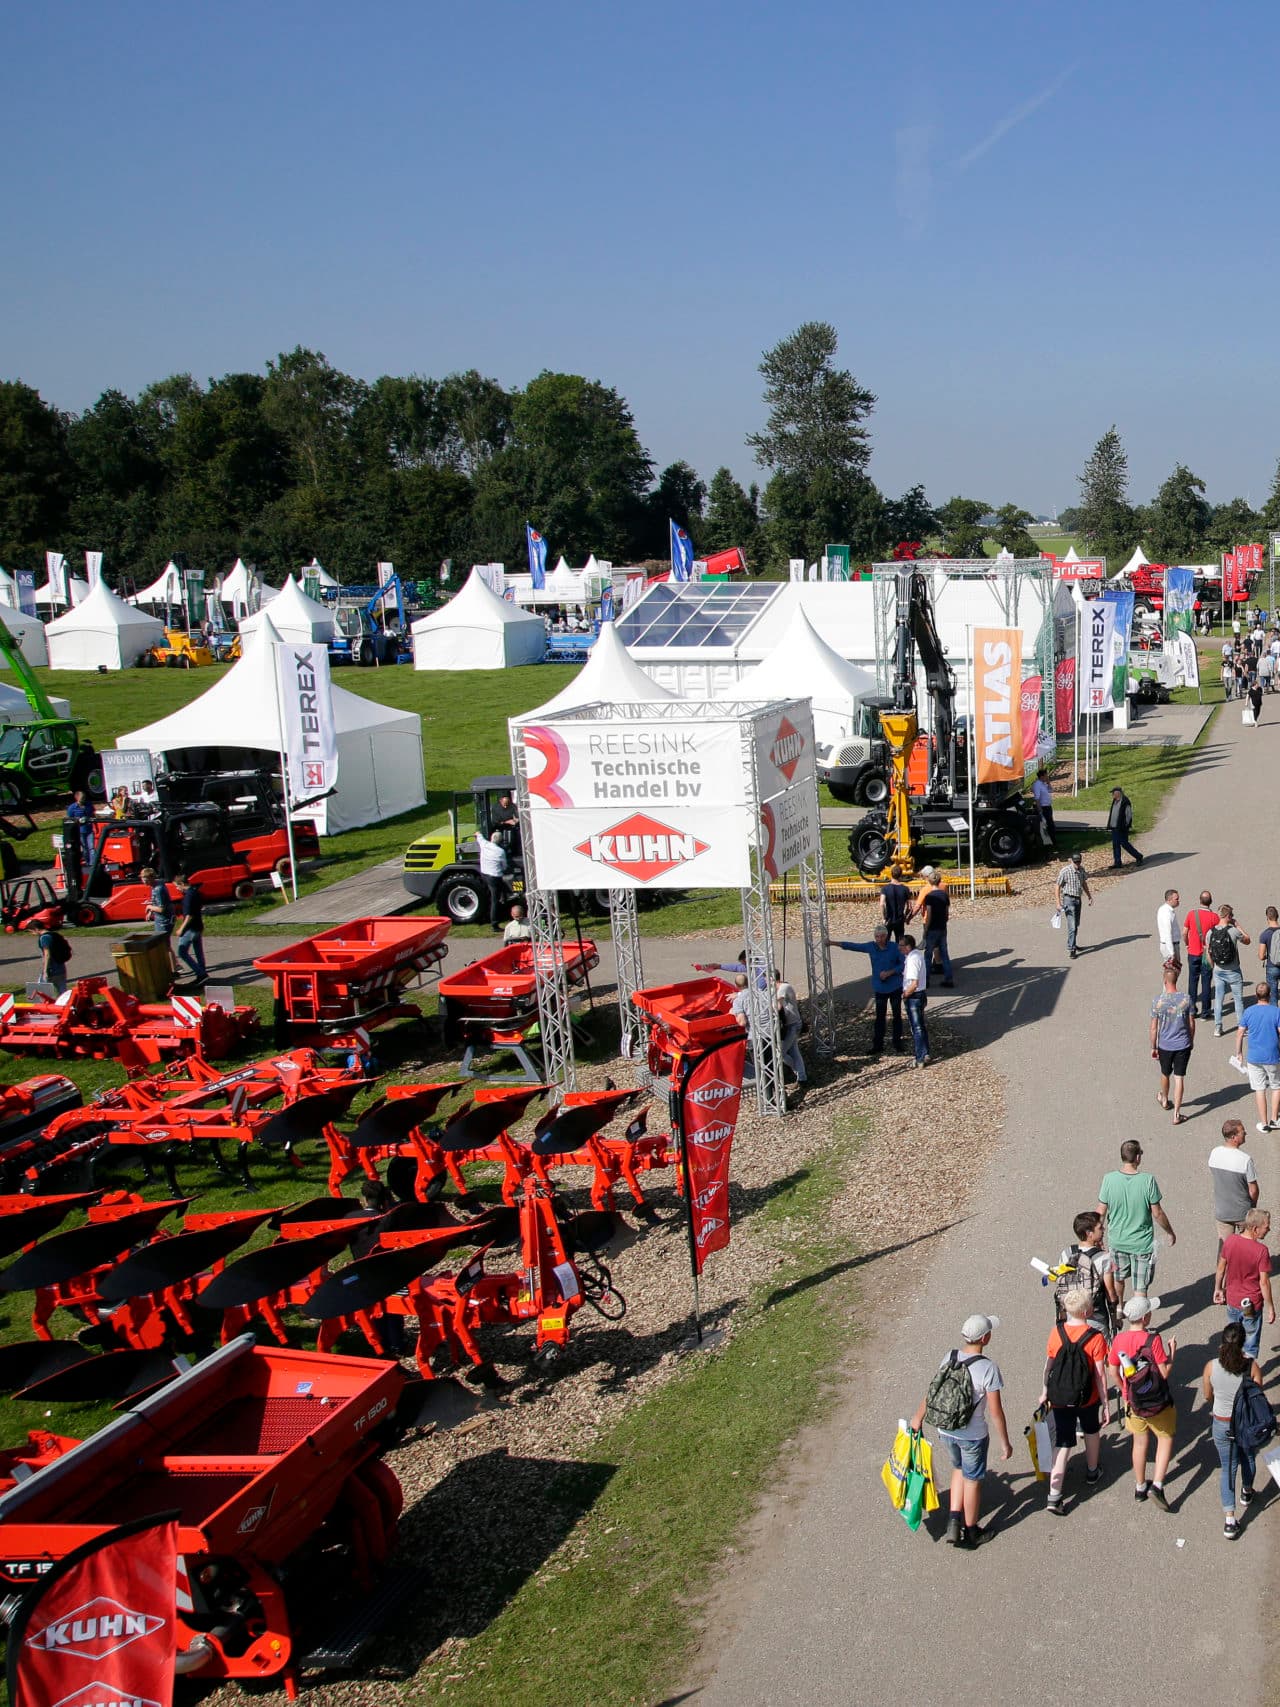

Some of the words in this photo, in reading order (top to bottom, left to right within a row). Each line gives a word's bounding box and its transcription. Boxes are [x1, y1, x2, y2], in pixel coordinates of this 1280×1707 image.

[1053, 563, 1100, 578] grifac
[1092, 607, 1106, 683] TEREX
[294, 650, 321, 754] TEREX
[983, 640, 1014, 768] ATLAS
[589, 732, 698, 756] REESINK
[773, 732, 801, 768] KUHN
[106, 754, 146, 766] WELKOM
[591, 759, 701, 777] Technische
[594, 780, 669, 799] Handel
[676, 780, 702, 798] bv
[781, 815, 809, 843] Technische
[589, 834, 696, 863] KUHN
[782, 835, 802, 865] Handel
[801, 833, 811, 850] bv
[693, 1085, 734, 1101] KUHN
[693, 1125, 732, 1145] KUHN
[353, 1415, 366, 1432] TF
[366, 1398, 388, 1421] 1500
[240, 1506, 265, 1533] KUHN
[5, 1562, 32, 1575] TF
[36, 1562, 56, 1575] 15
[45, 1614, 147, 1650] KUHN
